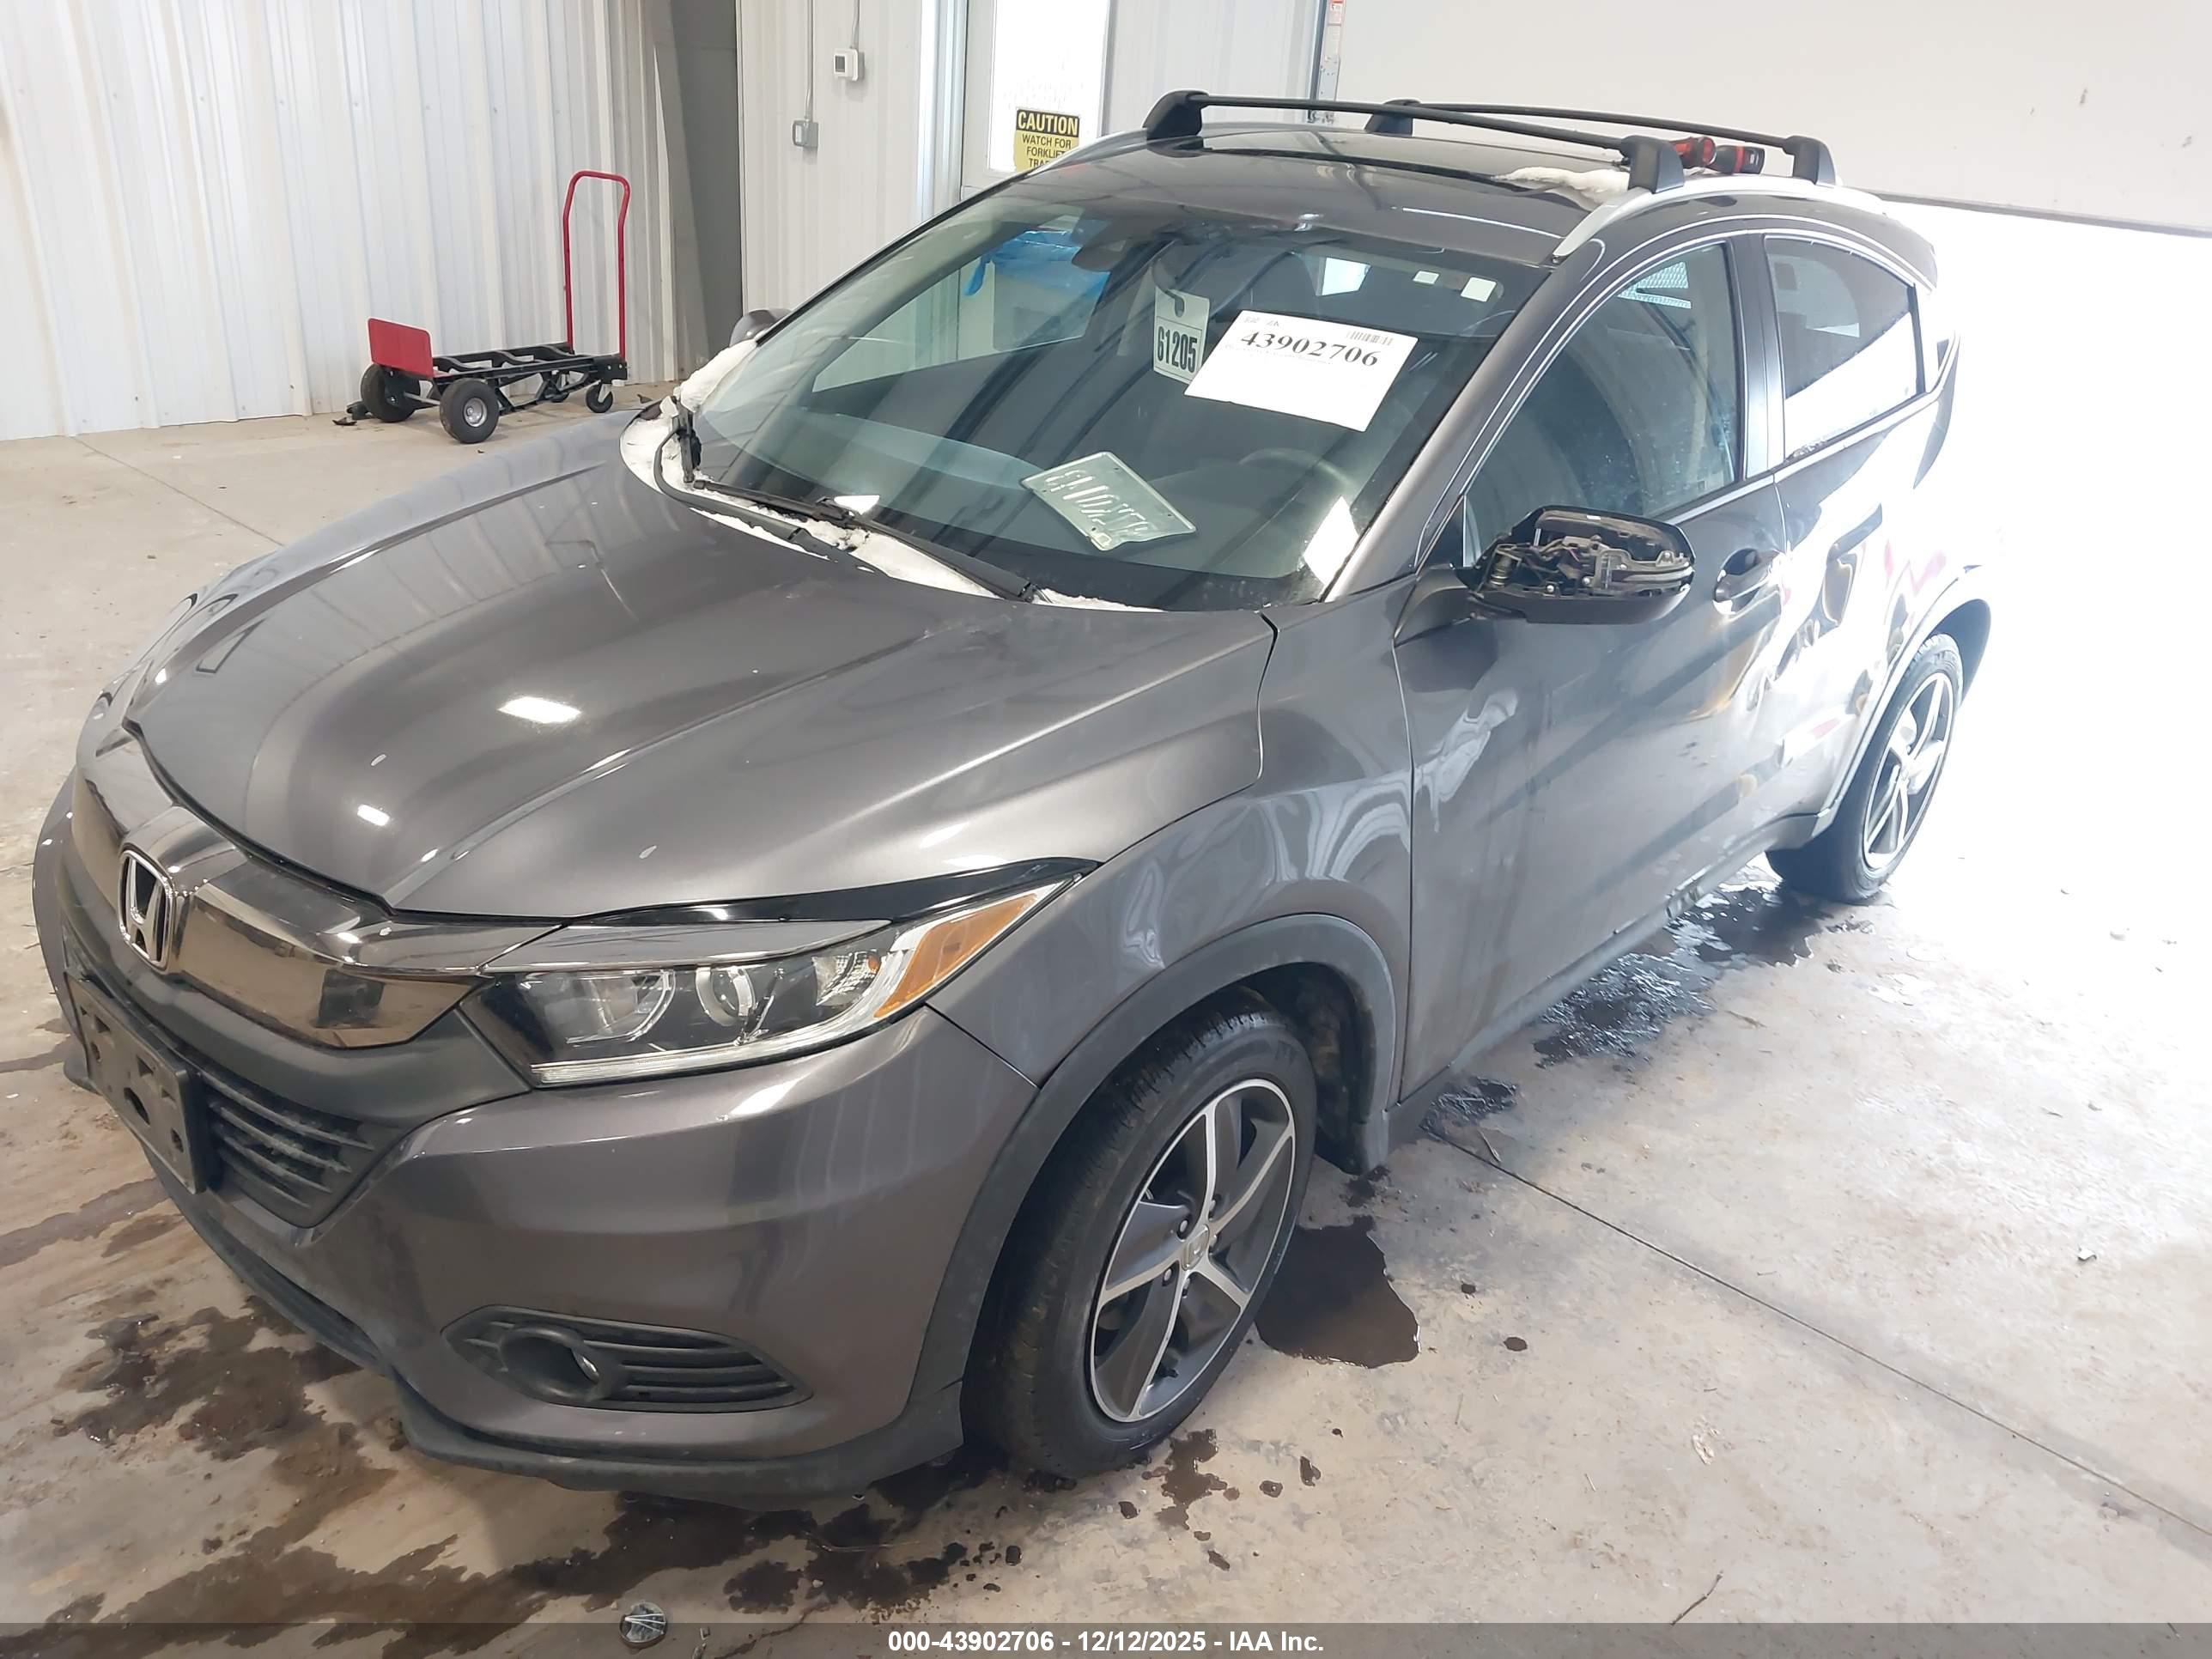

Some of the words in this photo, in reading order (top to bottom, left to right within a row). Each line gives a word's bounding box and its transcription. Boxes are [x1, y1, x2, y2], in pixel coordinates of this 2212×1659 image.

[1018, 111, 1078, 136] CAUTION
[1022, 133, 1052, 147] WATCH
[1054, 137, 1072, 149] FOR
[1157, 325, 1198, 373] 61205
[1241, 331, 1381, 367] 43902706
